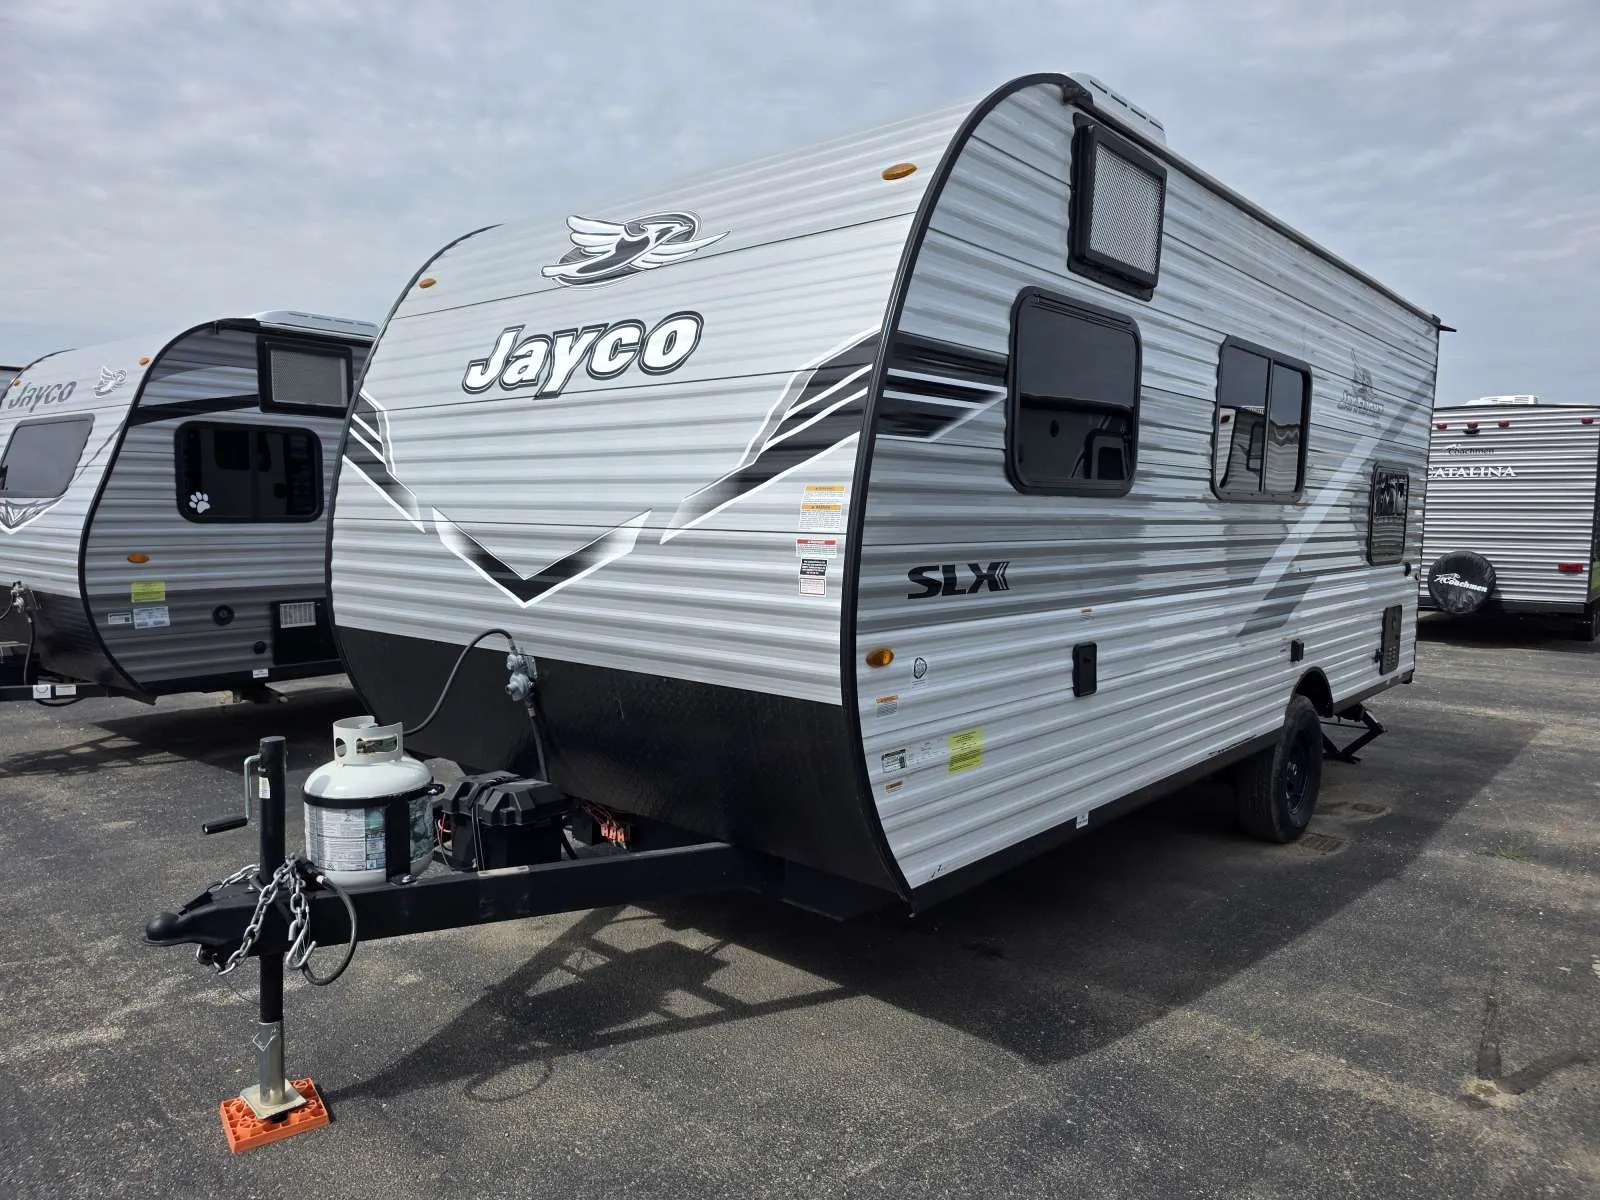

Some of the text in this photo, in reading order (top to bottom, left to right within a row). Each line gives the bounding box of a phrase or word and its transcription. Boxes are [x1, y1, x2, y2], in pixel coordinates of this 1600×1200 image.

[462, 311, 704, 400] Jayco
[7, 381, 77, 413] Jayco
[907, 561, 1010, 600] SLX
[1442, 577, 1488, 593] Coachmen
